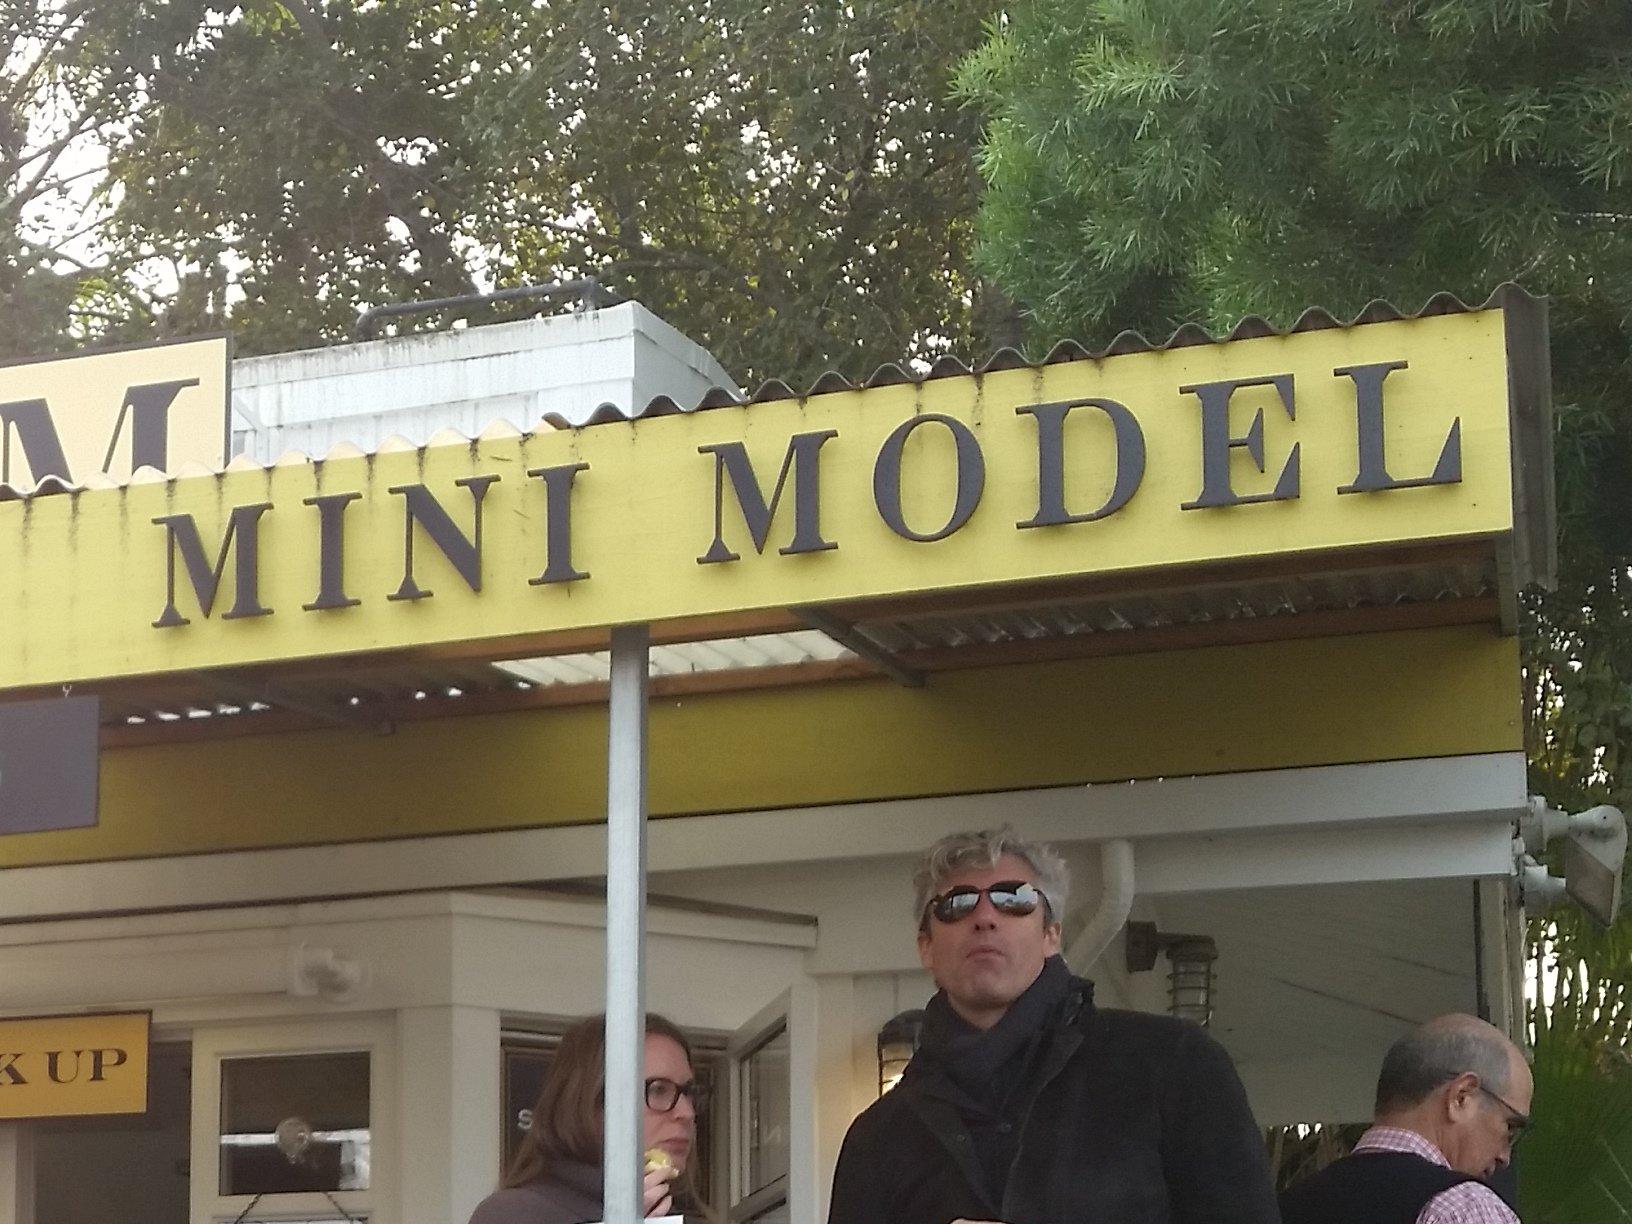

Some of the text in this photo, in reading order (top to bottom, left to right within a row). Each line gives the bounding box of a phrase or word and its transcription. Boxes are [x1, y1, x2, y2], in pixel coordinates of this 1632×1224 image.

[151, 360, 1463, 628] MINI MODEL
[46, 1048, 128, 1084] UP
